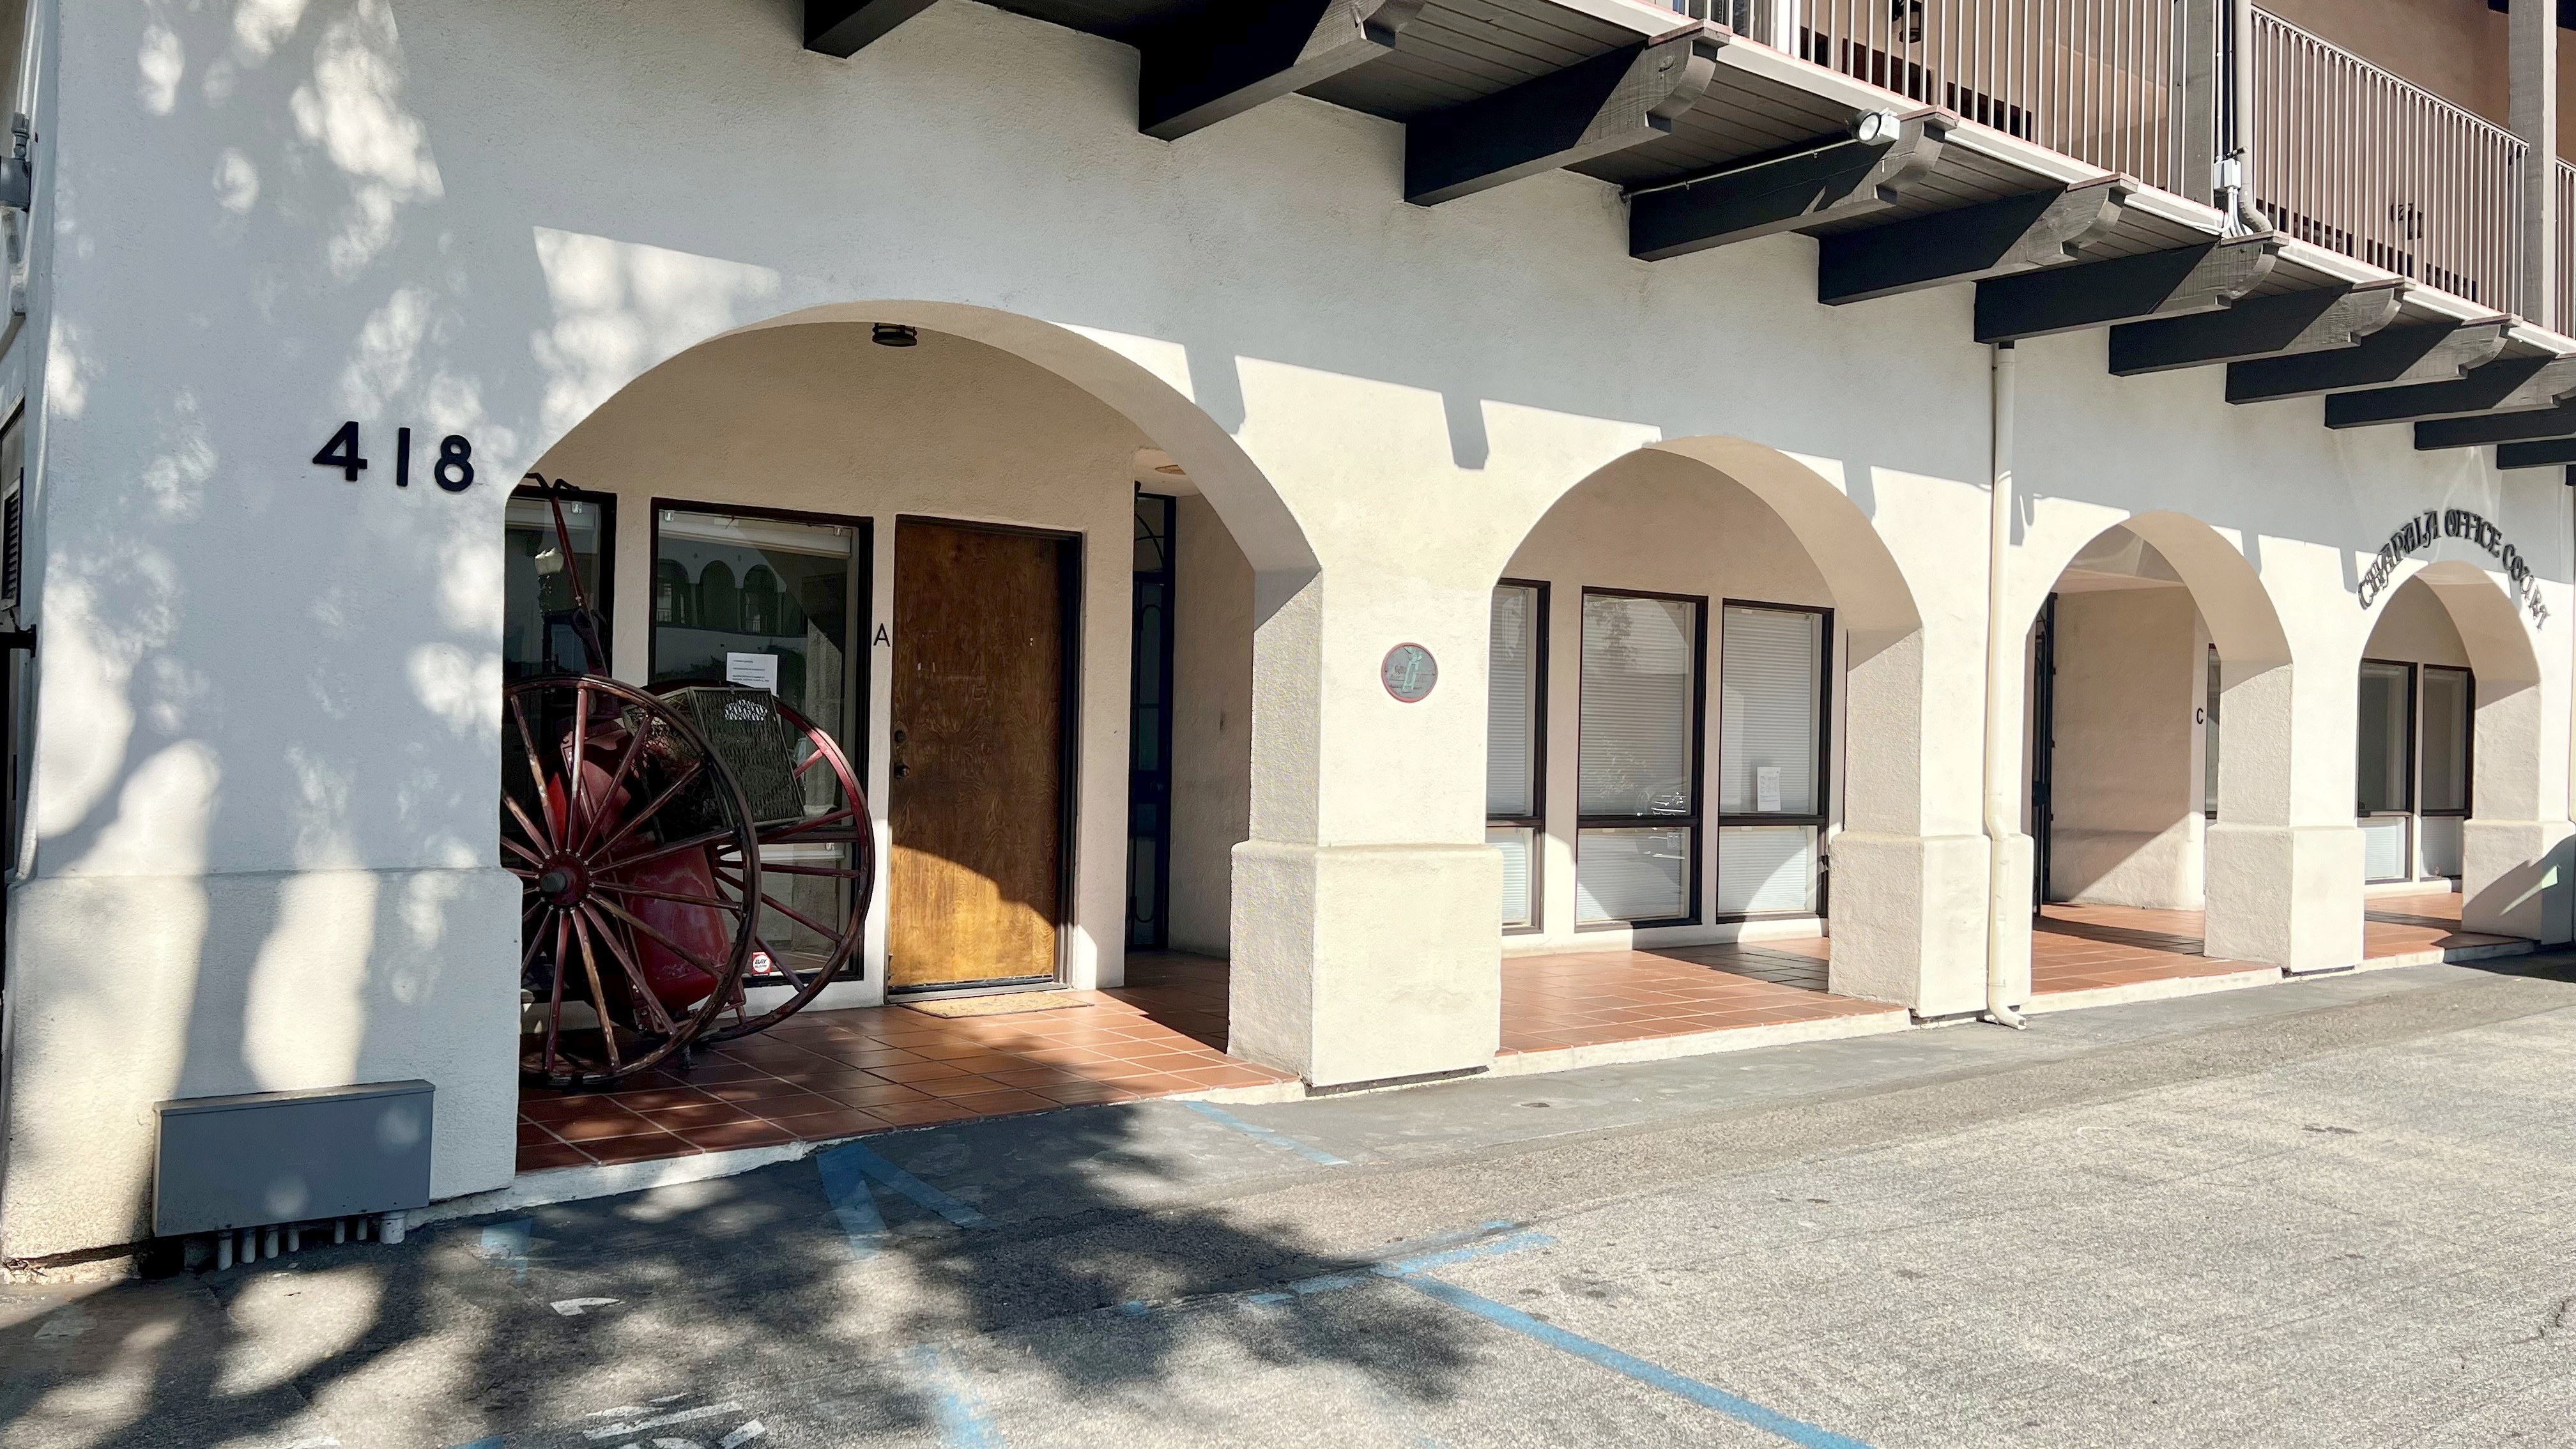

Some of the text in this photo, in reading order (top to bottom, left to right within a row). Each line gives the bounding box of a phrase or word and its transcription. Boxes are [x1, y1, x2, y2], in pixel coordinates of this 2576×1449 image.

[312, 421, 474, 492] 418
[2358, 509, 2552, 631] CHAPALA OFFICE COURT
[873, 622, 891, 647] A
[2196, 707, 2204, 724] C
